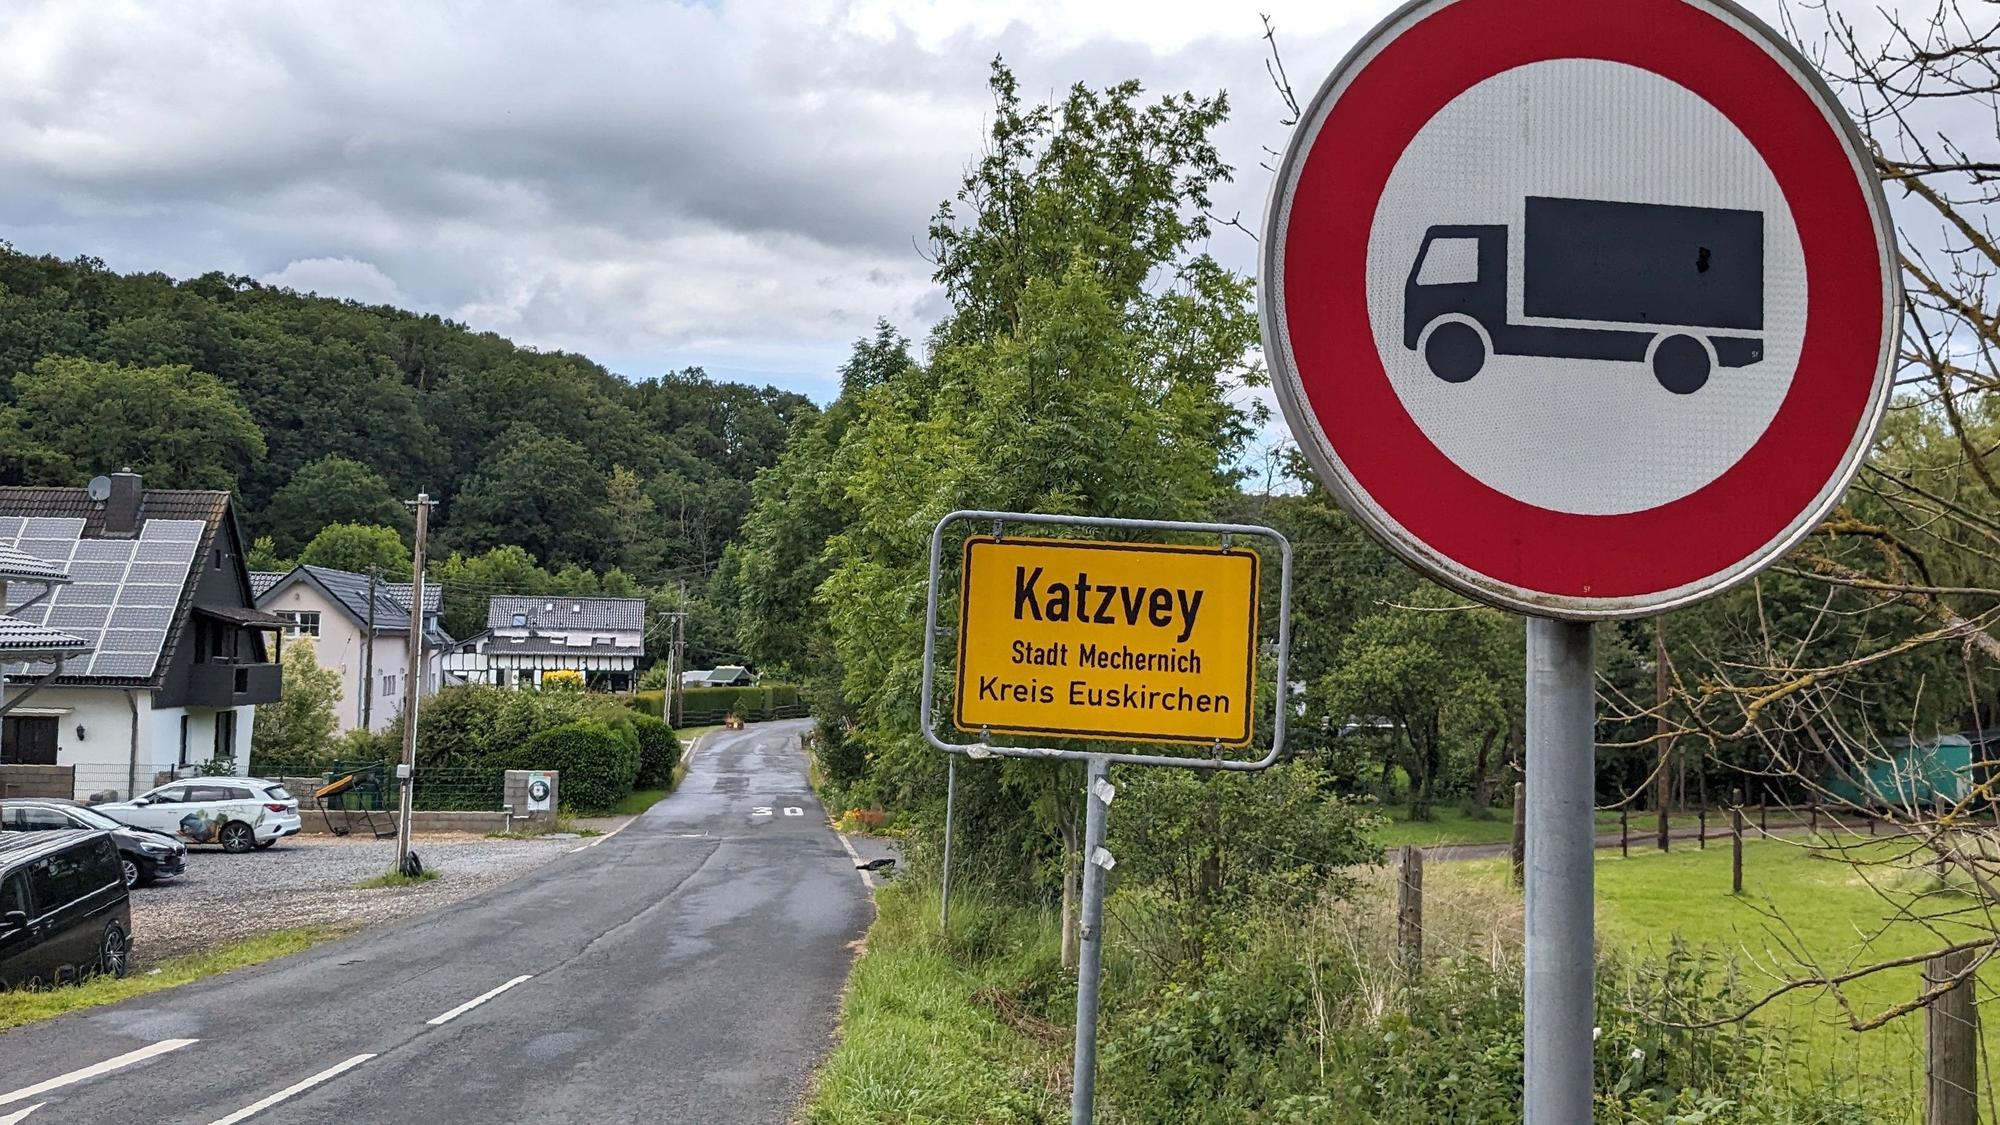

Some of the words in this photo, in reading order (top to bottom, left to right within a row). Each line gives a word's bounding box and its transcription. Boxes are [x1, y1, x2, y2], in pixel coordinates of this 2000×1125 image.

[1013, 565, 1204, 644] Katzvey
[1011, 639, 1068, 667] Stadt
[1079, 643, 1201, 674] Mechernich
[979, 675, 1054, 704] Kreis
[1069, 680, 1230, 714] Euskirchen
[752, 806, 804, 816] 30
